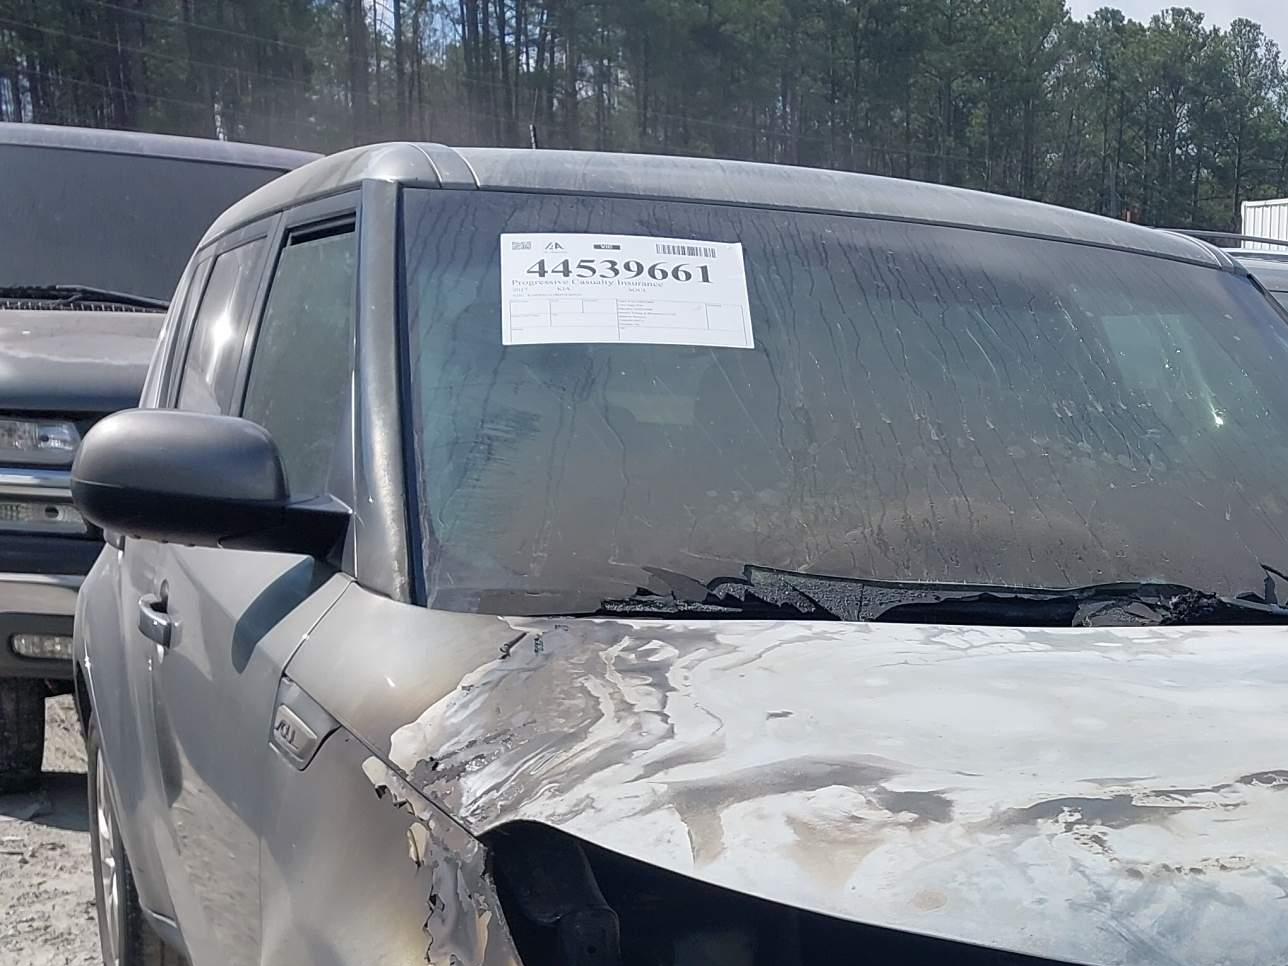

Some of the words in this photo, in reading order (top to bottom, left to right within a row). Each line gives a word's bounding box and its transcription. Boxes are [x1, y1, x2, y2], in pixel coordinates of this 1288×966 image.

[526, 259, 713, 284] 44539661
[512, 280, 569, 288] Progressive
[571, 280, 614, 289] Casualty
[617, 280, 664, 288] Insurance
